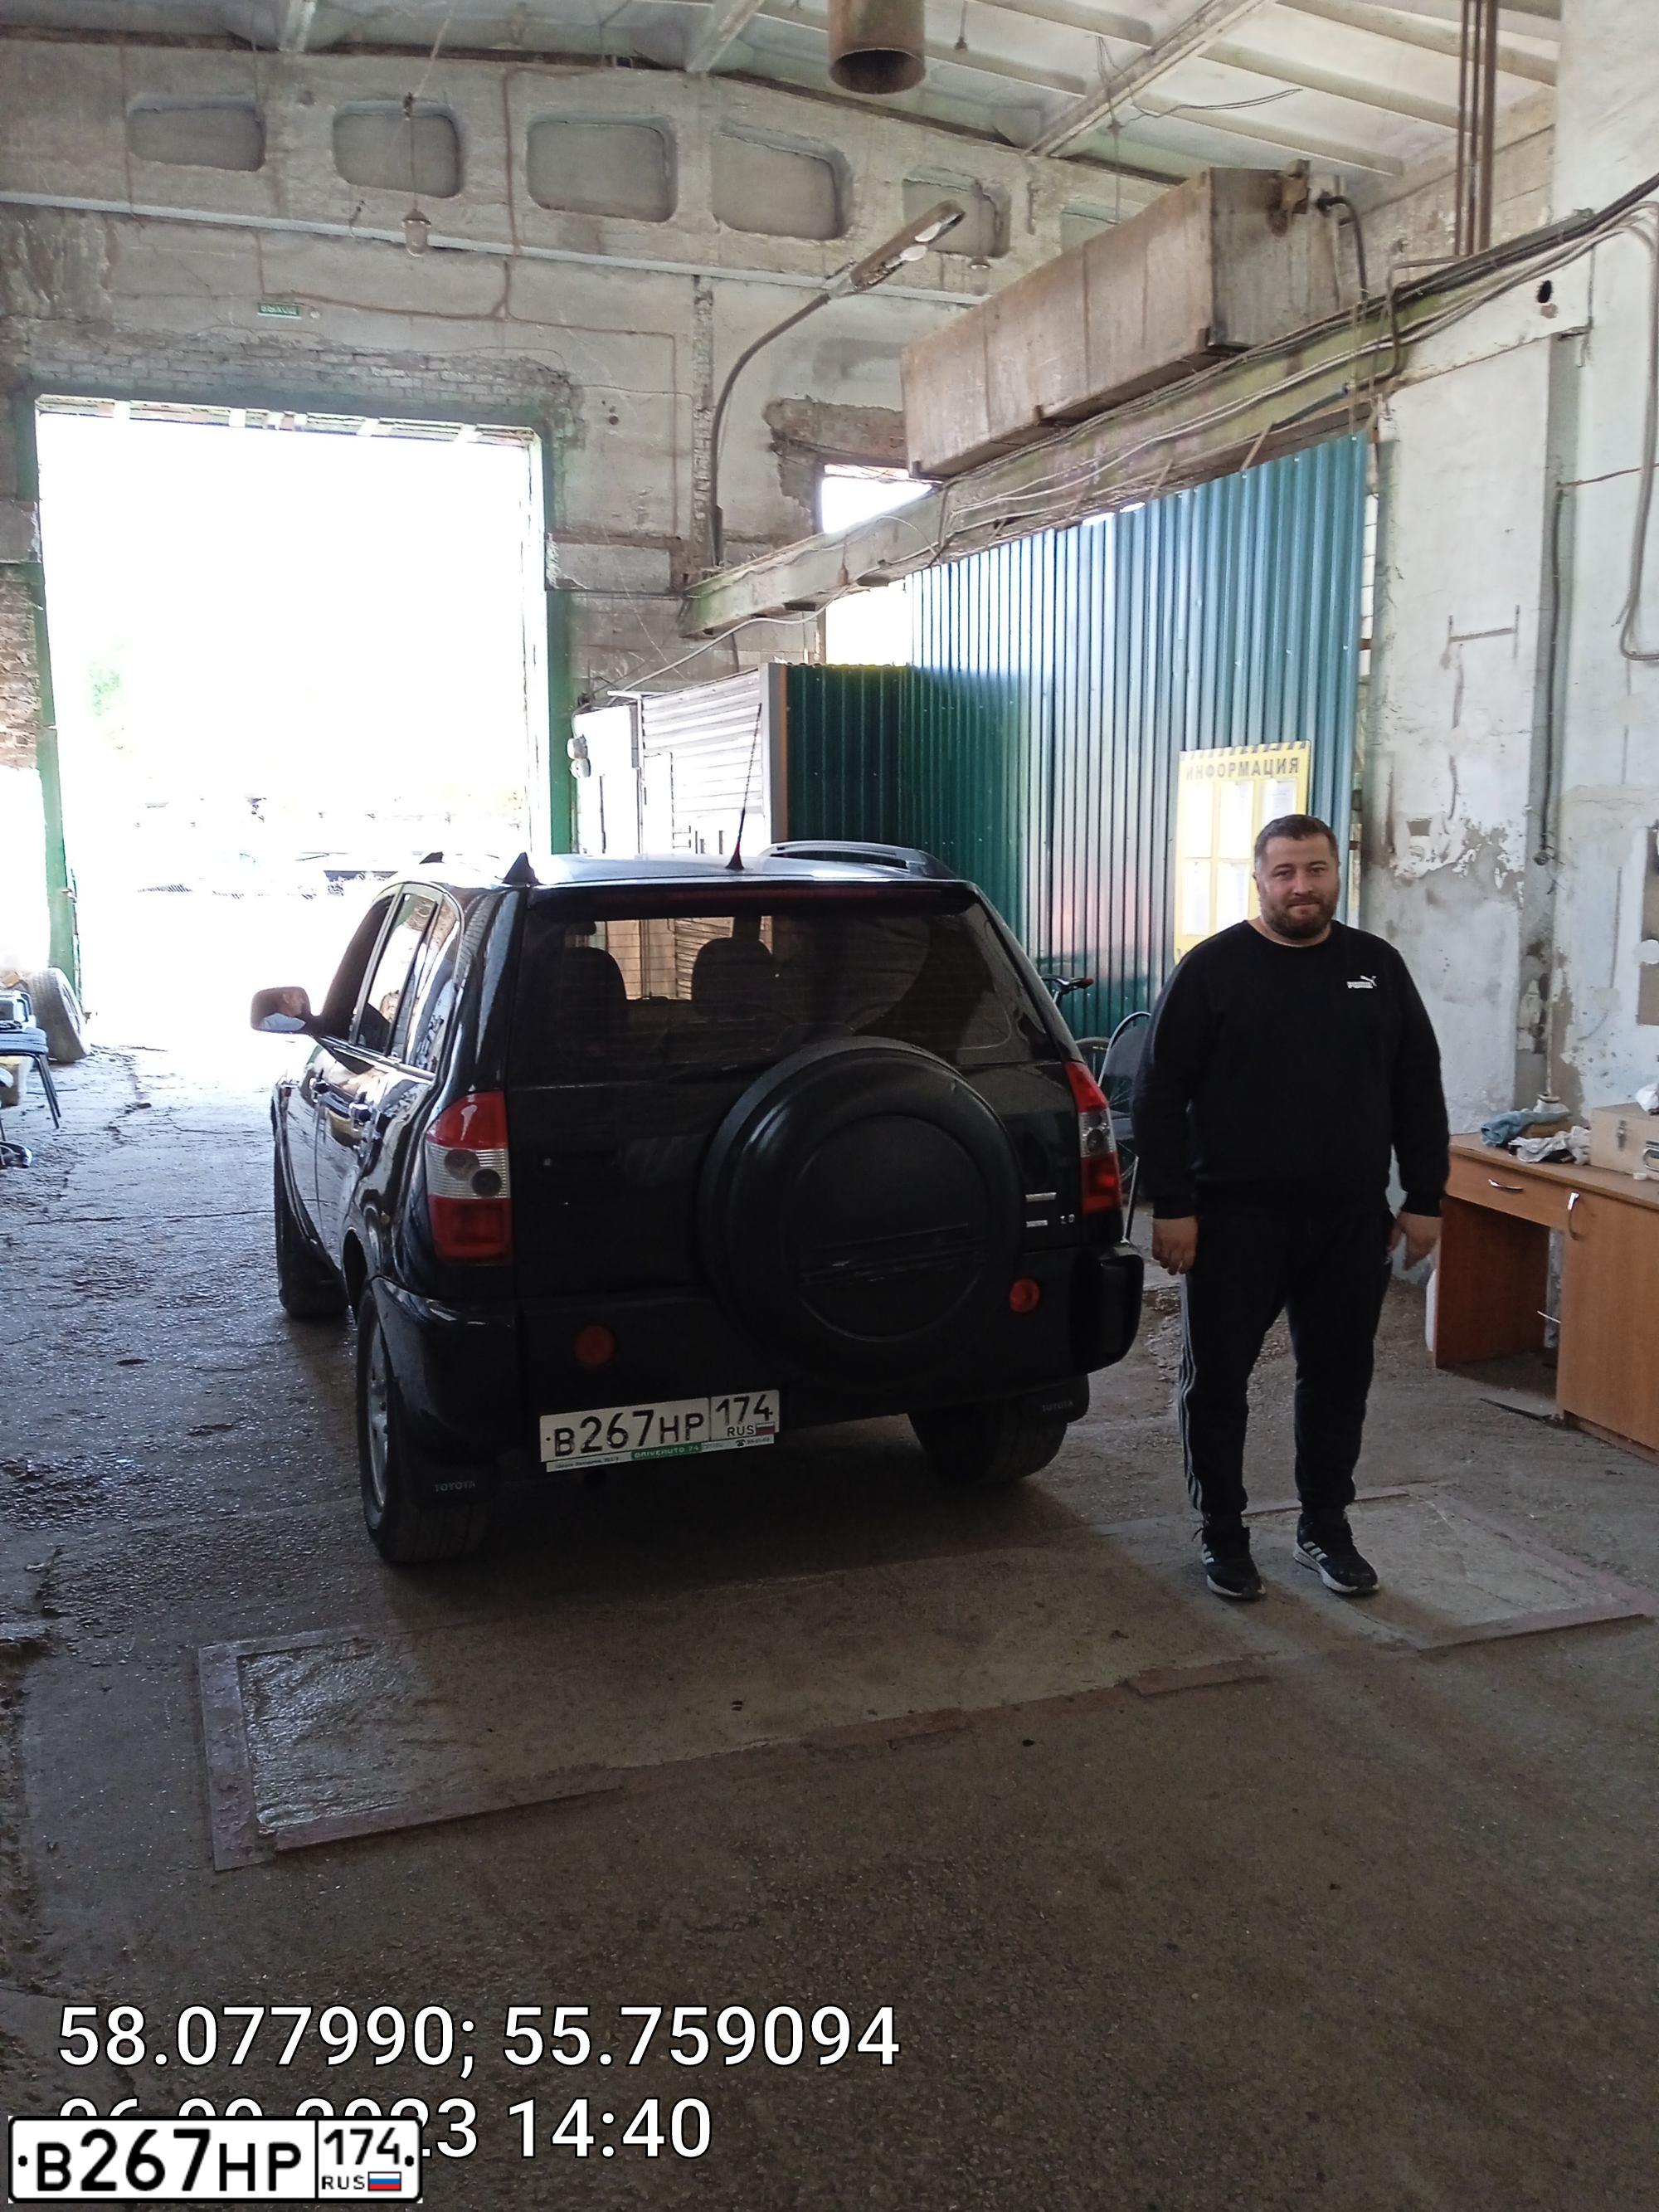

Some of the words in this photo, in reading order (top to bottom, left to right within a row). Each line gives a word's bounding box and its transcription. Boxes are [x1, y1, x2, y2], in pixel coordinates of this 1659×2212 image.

[1185, 757, 1300, 780] ИНФОРМАЦИЯ
[554, 1409, 704, 1458] В267НР
[715, 1394, 771, 1425] 174
[727, 1424, 755, 1437] RUS
